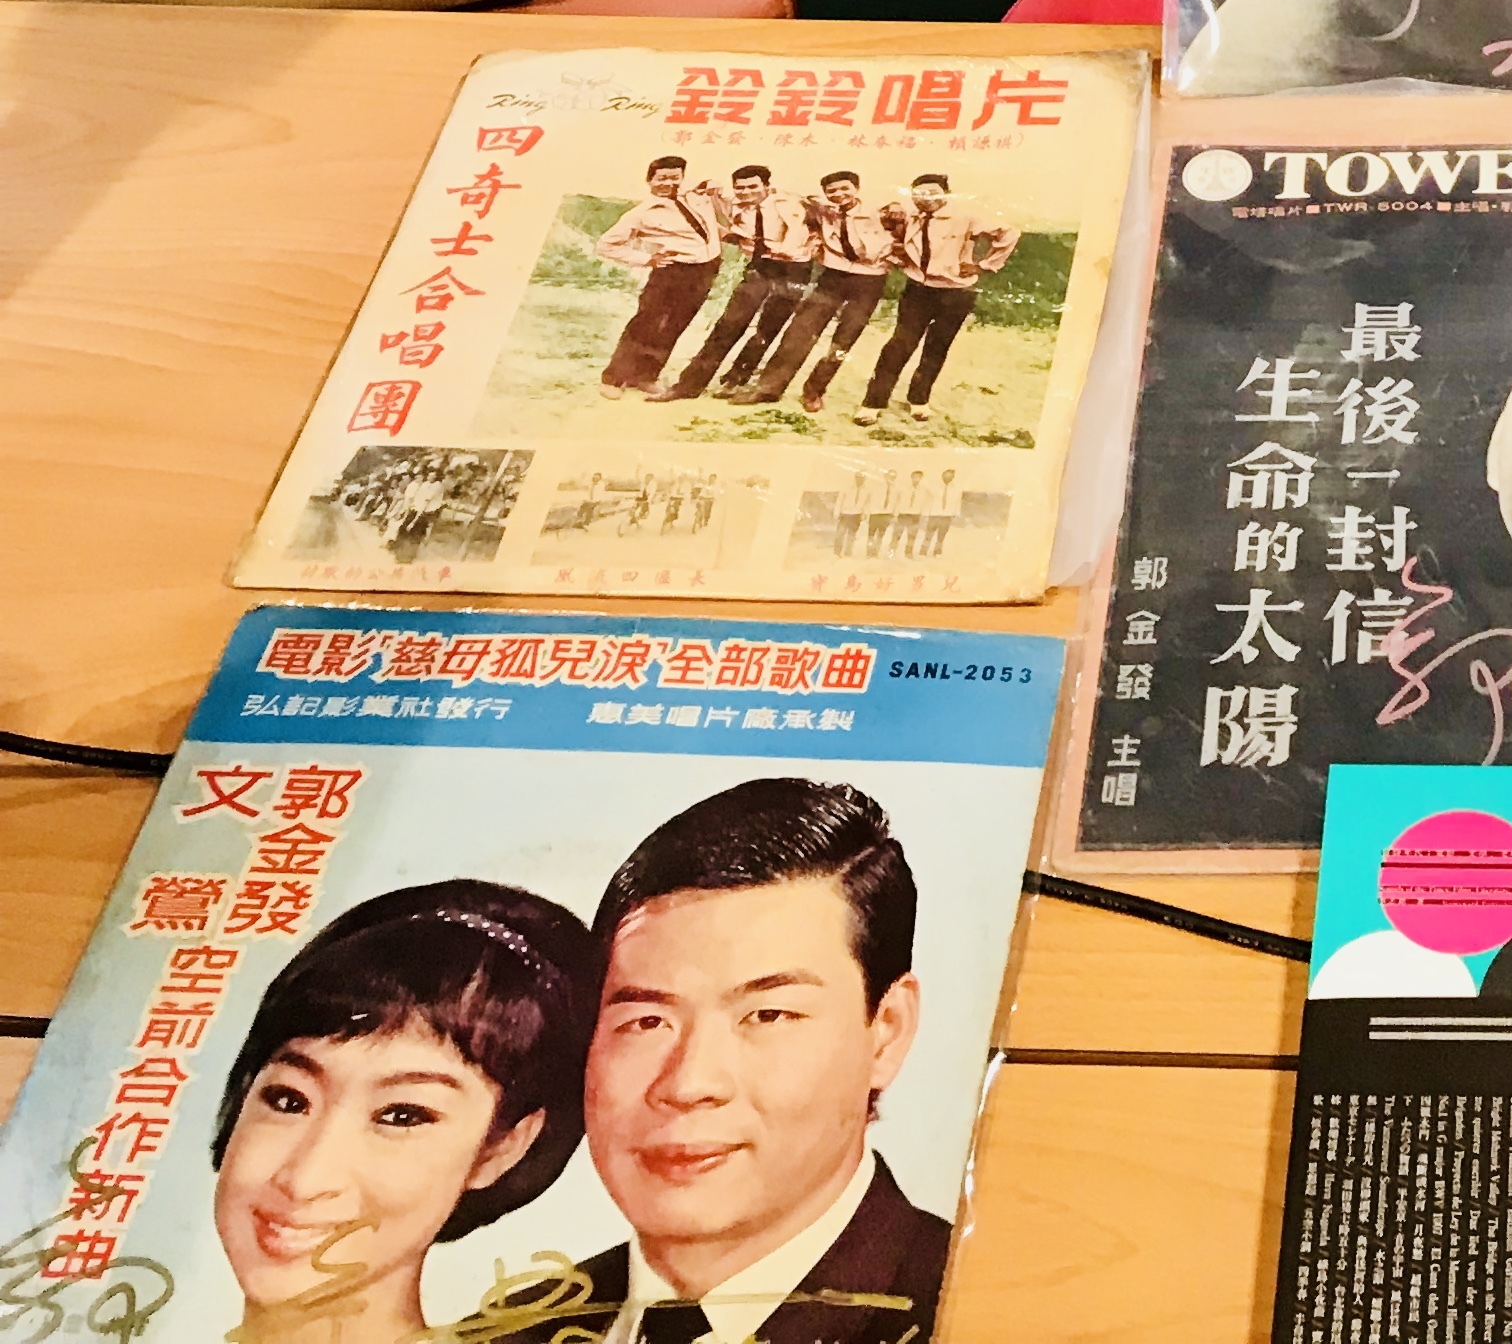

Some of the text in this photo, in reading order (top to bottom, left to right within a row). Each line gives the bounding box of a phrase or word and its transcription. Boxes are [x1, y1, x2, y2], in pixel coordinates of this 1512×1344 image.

[486, 92, 664, 119] Ring Ring
[663, 66, 1070, 132] 鈴鈴唱片
[346, 124, 545, 438] 四奇士合唱團
[1200, 357, 1323, 768] 生命的太陽
[1322, 301, 1423, 667] 最後一封信
[888, 660, 1034, 685] SANL-2053
[1100, 556, 1169, 808] 郭金發 主唱
[223, 763, 363, 936] 郭金發
[40, 943, 240, 1282] 空前合作新曲
